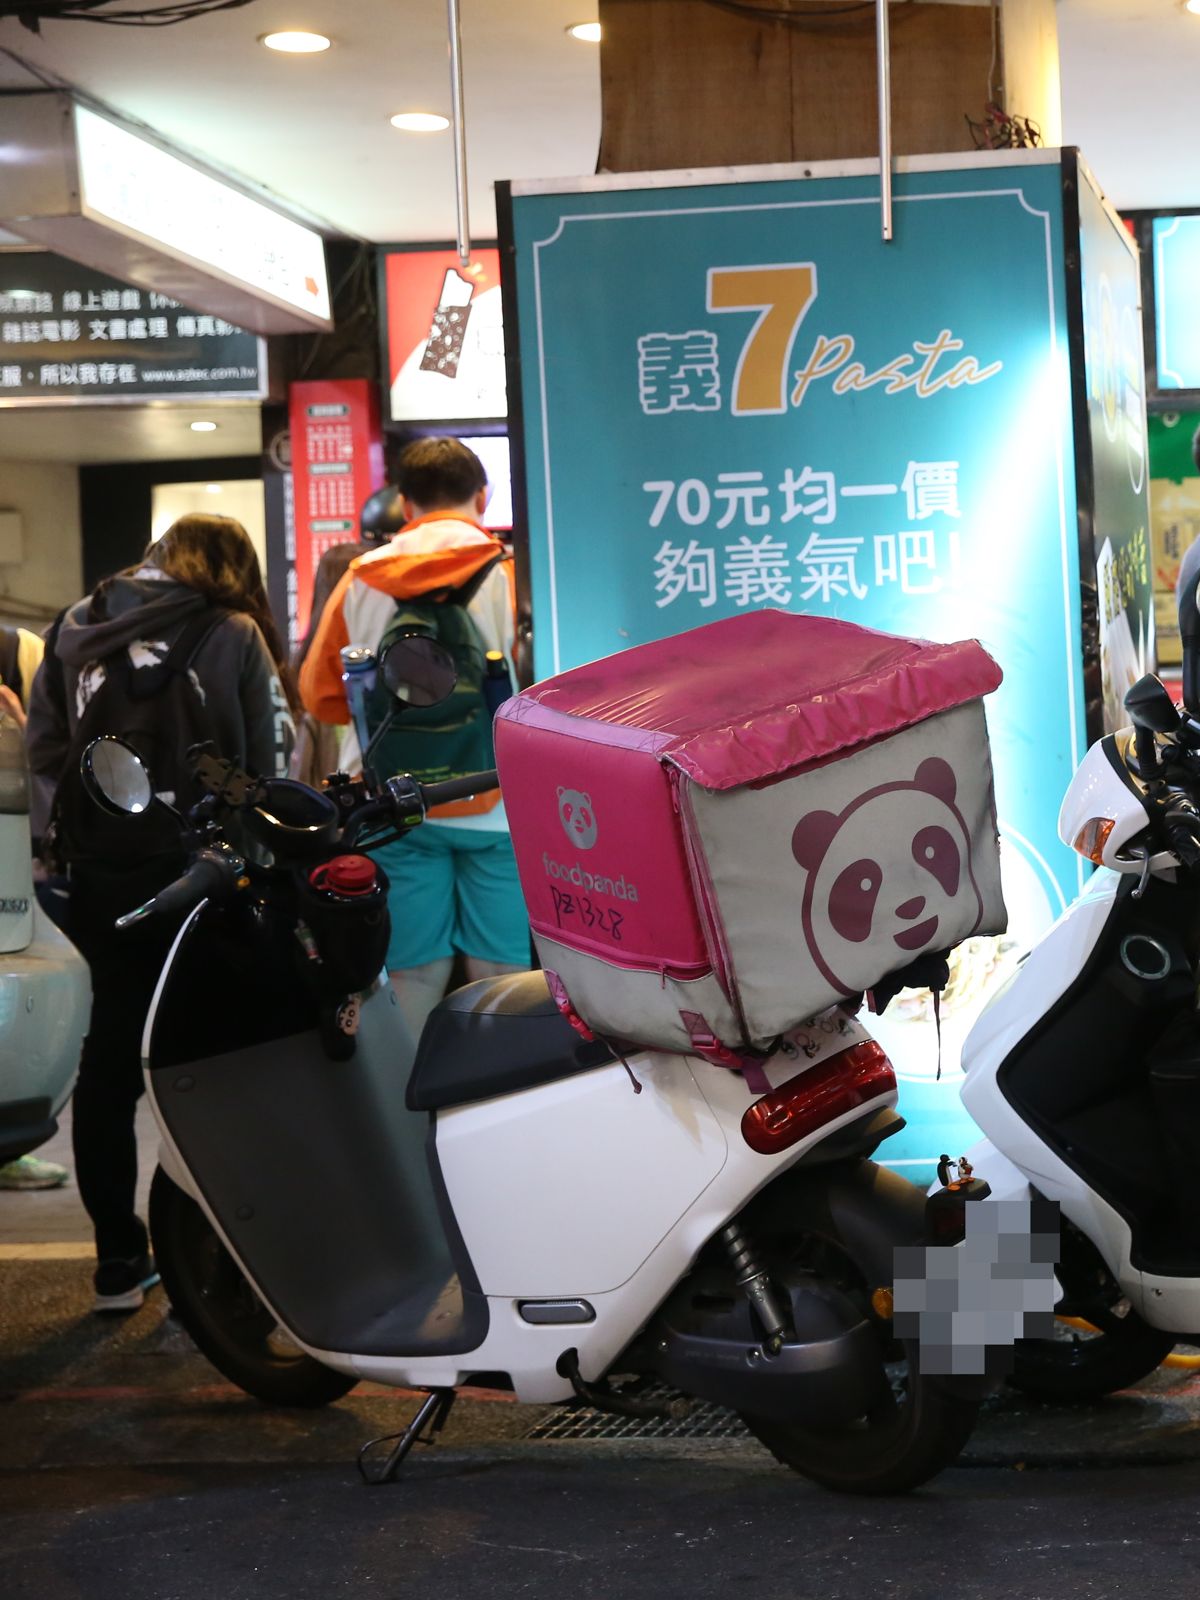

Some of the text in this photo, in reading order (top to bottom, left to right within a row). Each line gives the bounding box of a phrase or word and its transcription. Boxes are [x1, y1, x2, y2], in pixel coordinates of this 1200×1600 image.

[790, 329, 1002, 408] Pasta
[643, 460, 961, 529] 70元均一價
[543, 852, 639, 903] foodpanda
